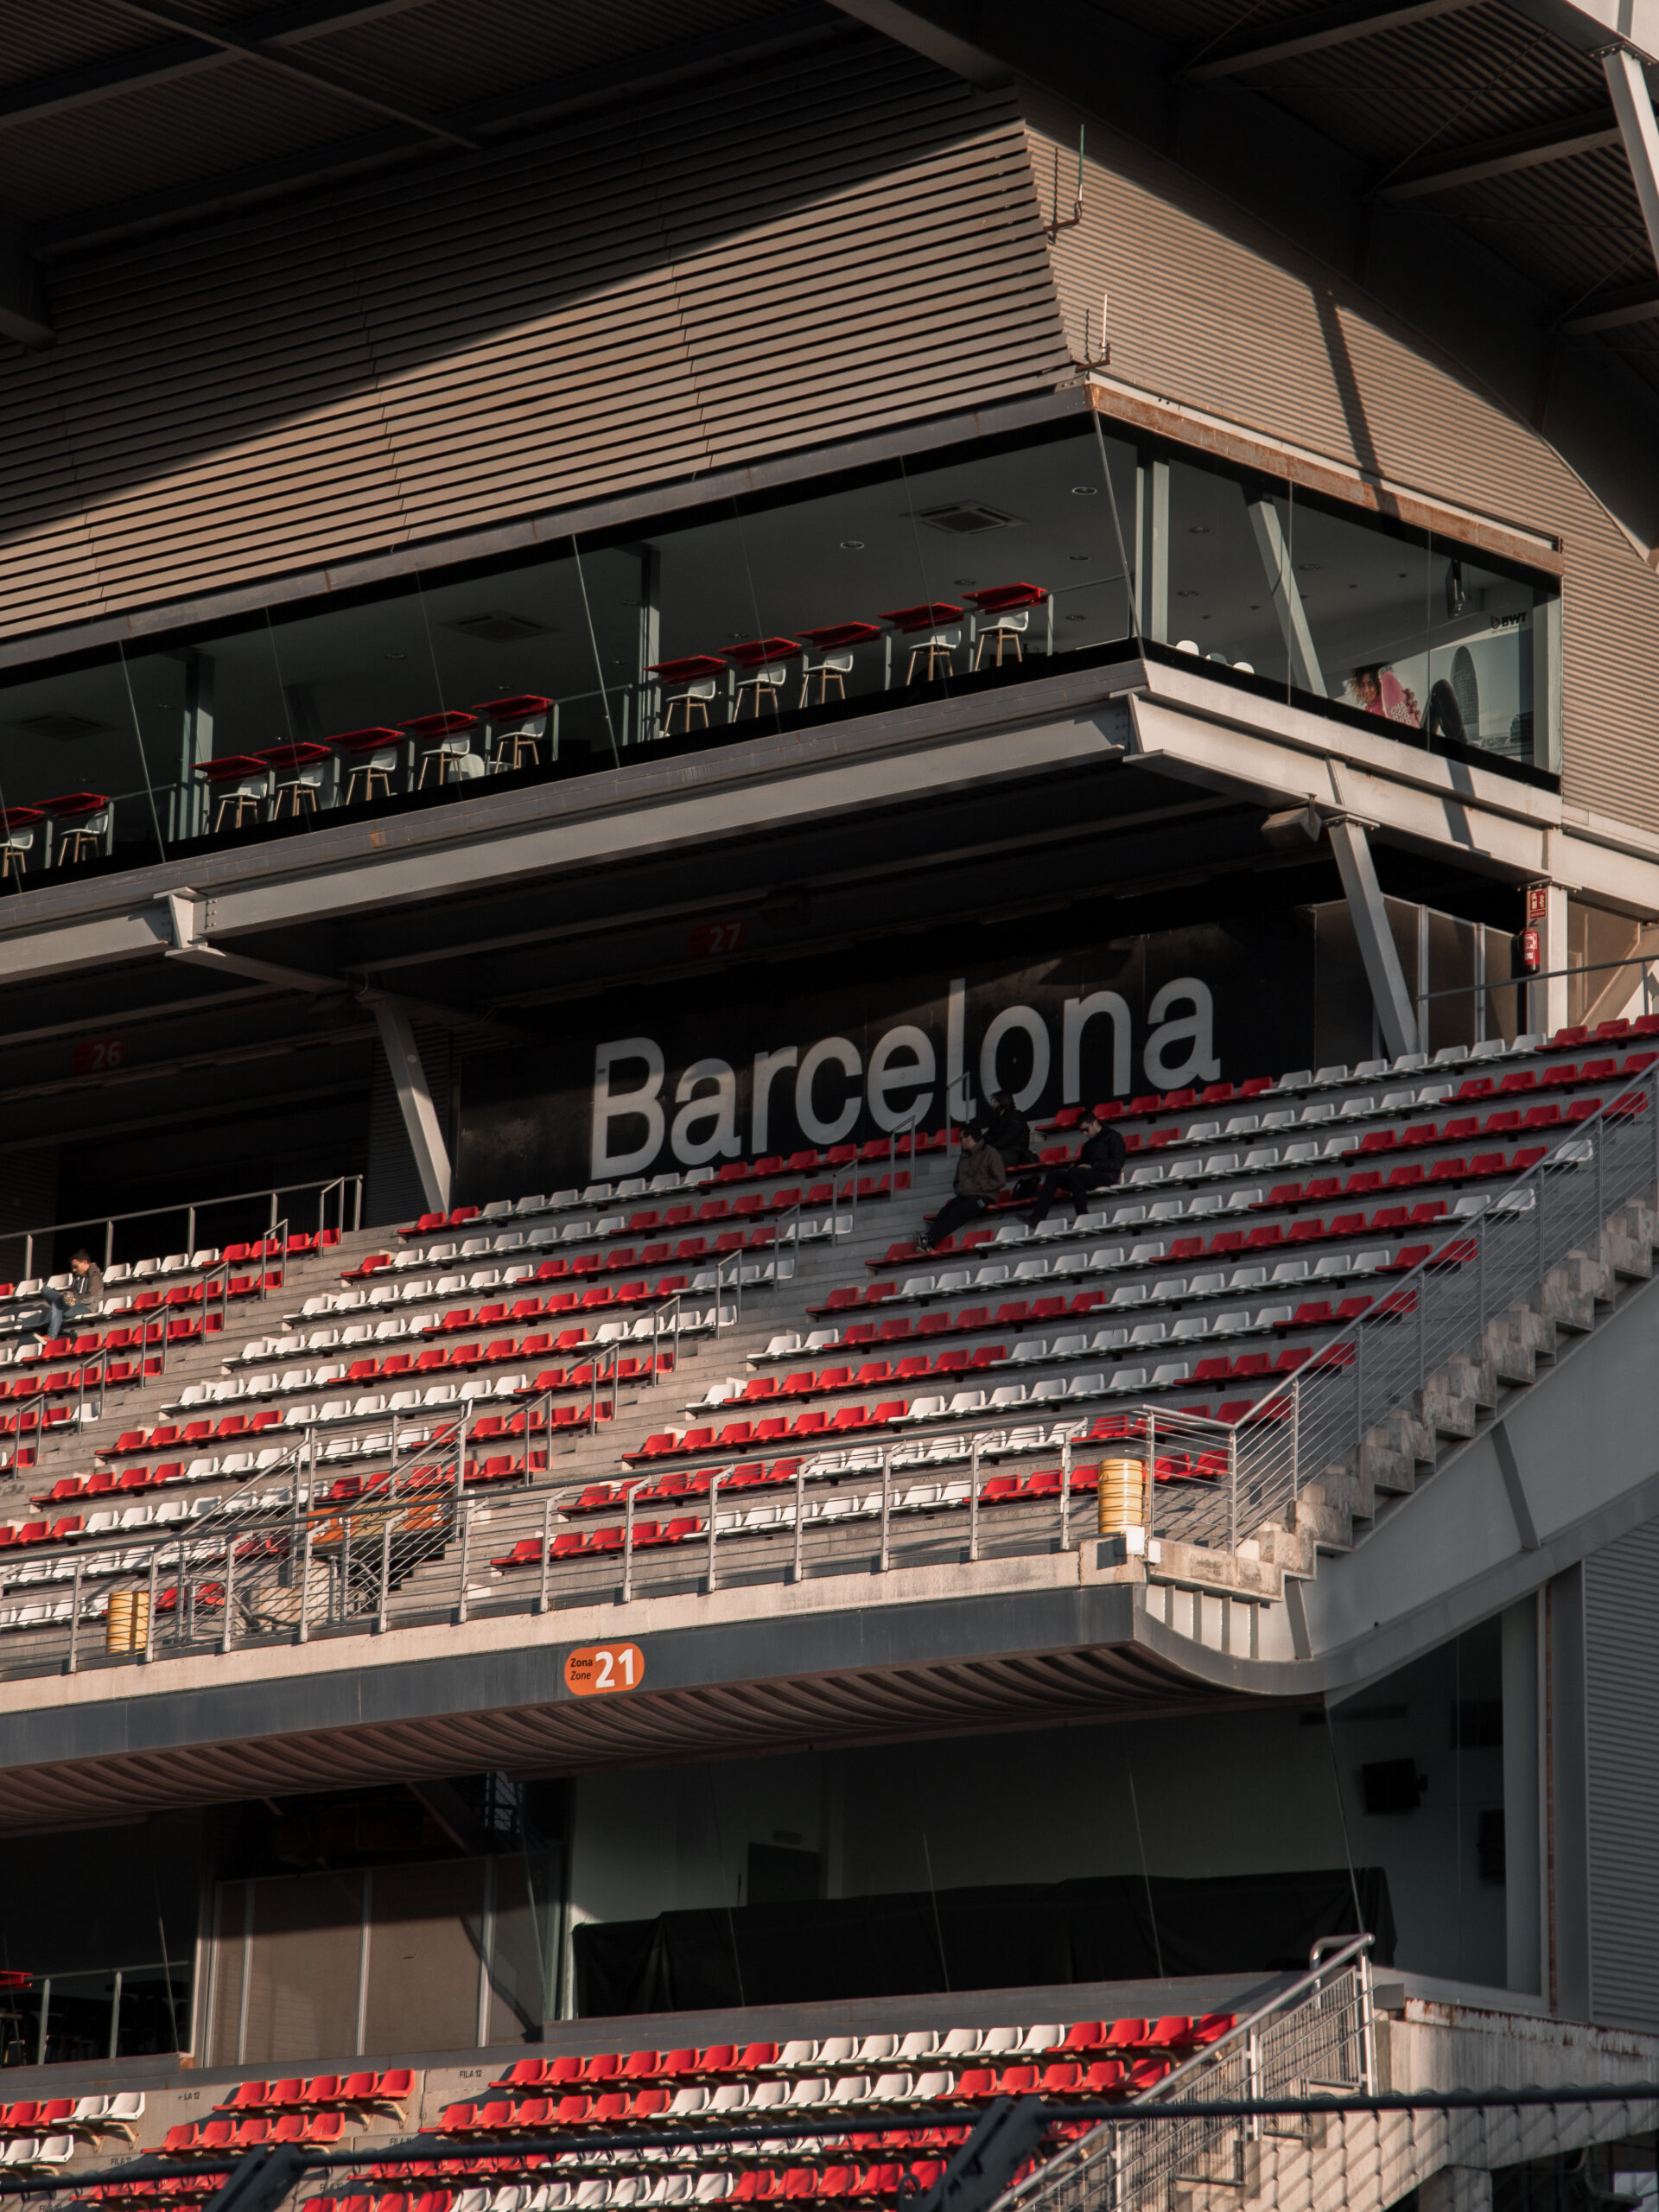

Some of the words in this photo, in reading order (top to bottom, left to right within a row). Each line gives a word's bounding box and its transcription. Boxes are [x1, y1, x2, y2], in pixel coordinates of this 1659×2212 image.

[1502, 612, 1528, 626] BWT
[709, 922, 742, 955] 27
[92, 1039, 122, 1070] 26
[590, 977, 1221, 1180] Barcelona
[570, 1658, 593, 1668] Zona
[595, 1648, 634, 1689] 21
[570, 1670, 592, 1681] Zone
[459, 2069, 474, 2079] FILA
[475, 2069, 483, 2078] 12
[111, 2157, 124, 2166] FILA
